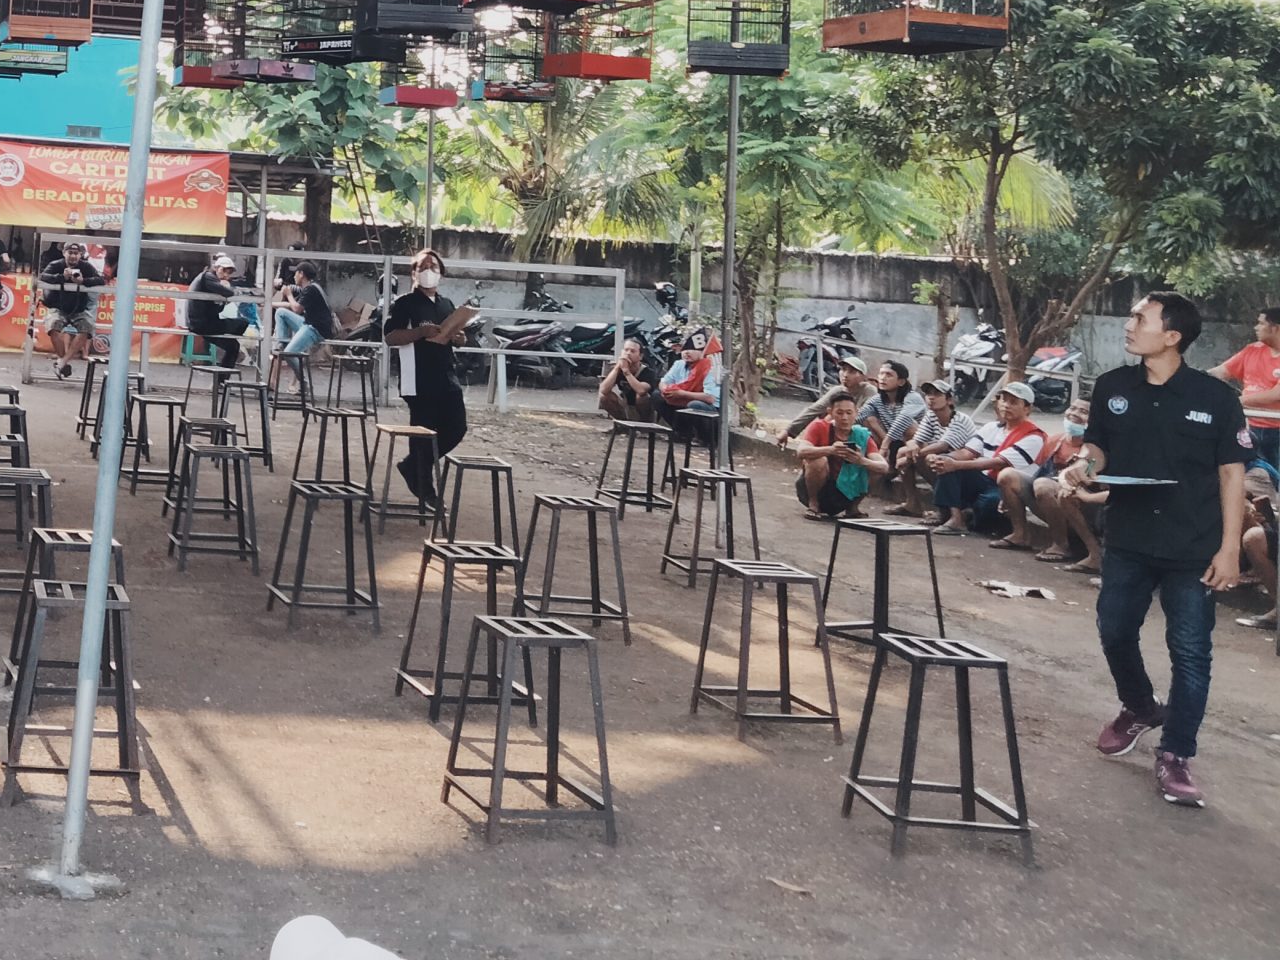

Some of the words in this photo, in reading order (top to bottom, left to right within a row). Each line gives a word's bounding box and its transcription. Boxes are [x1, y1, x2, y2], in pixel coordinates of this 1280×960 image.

[28, 147, 78, 160] LOMBA
[81, 150, 129, 163] BURUN
[149, 153, 192, 166] UKAN
[50, 161, 106, 178] CARI
[115, 165, 166, 180] DIT
[23, 188, 99, 204] BERADU
[1185, 410, 1213, 424] JURI
